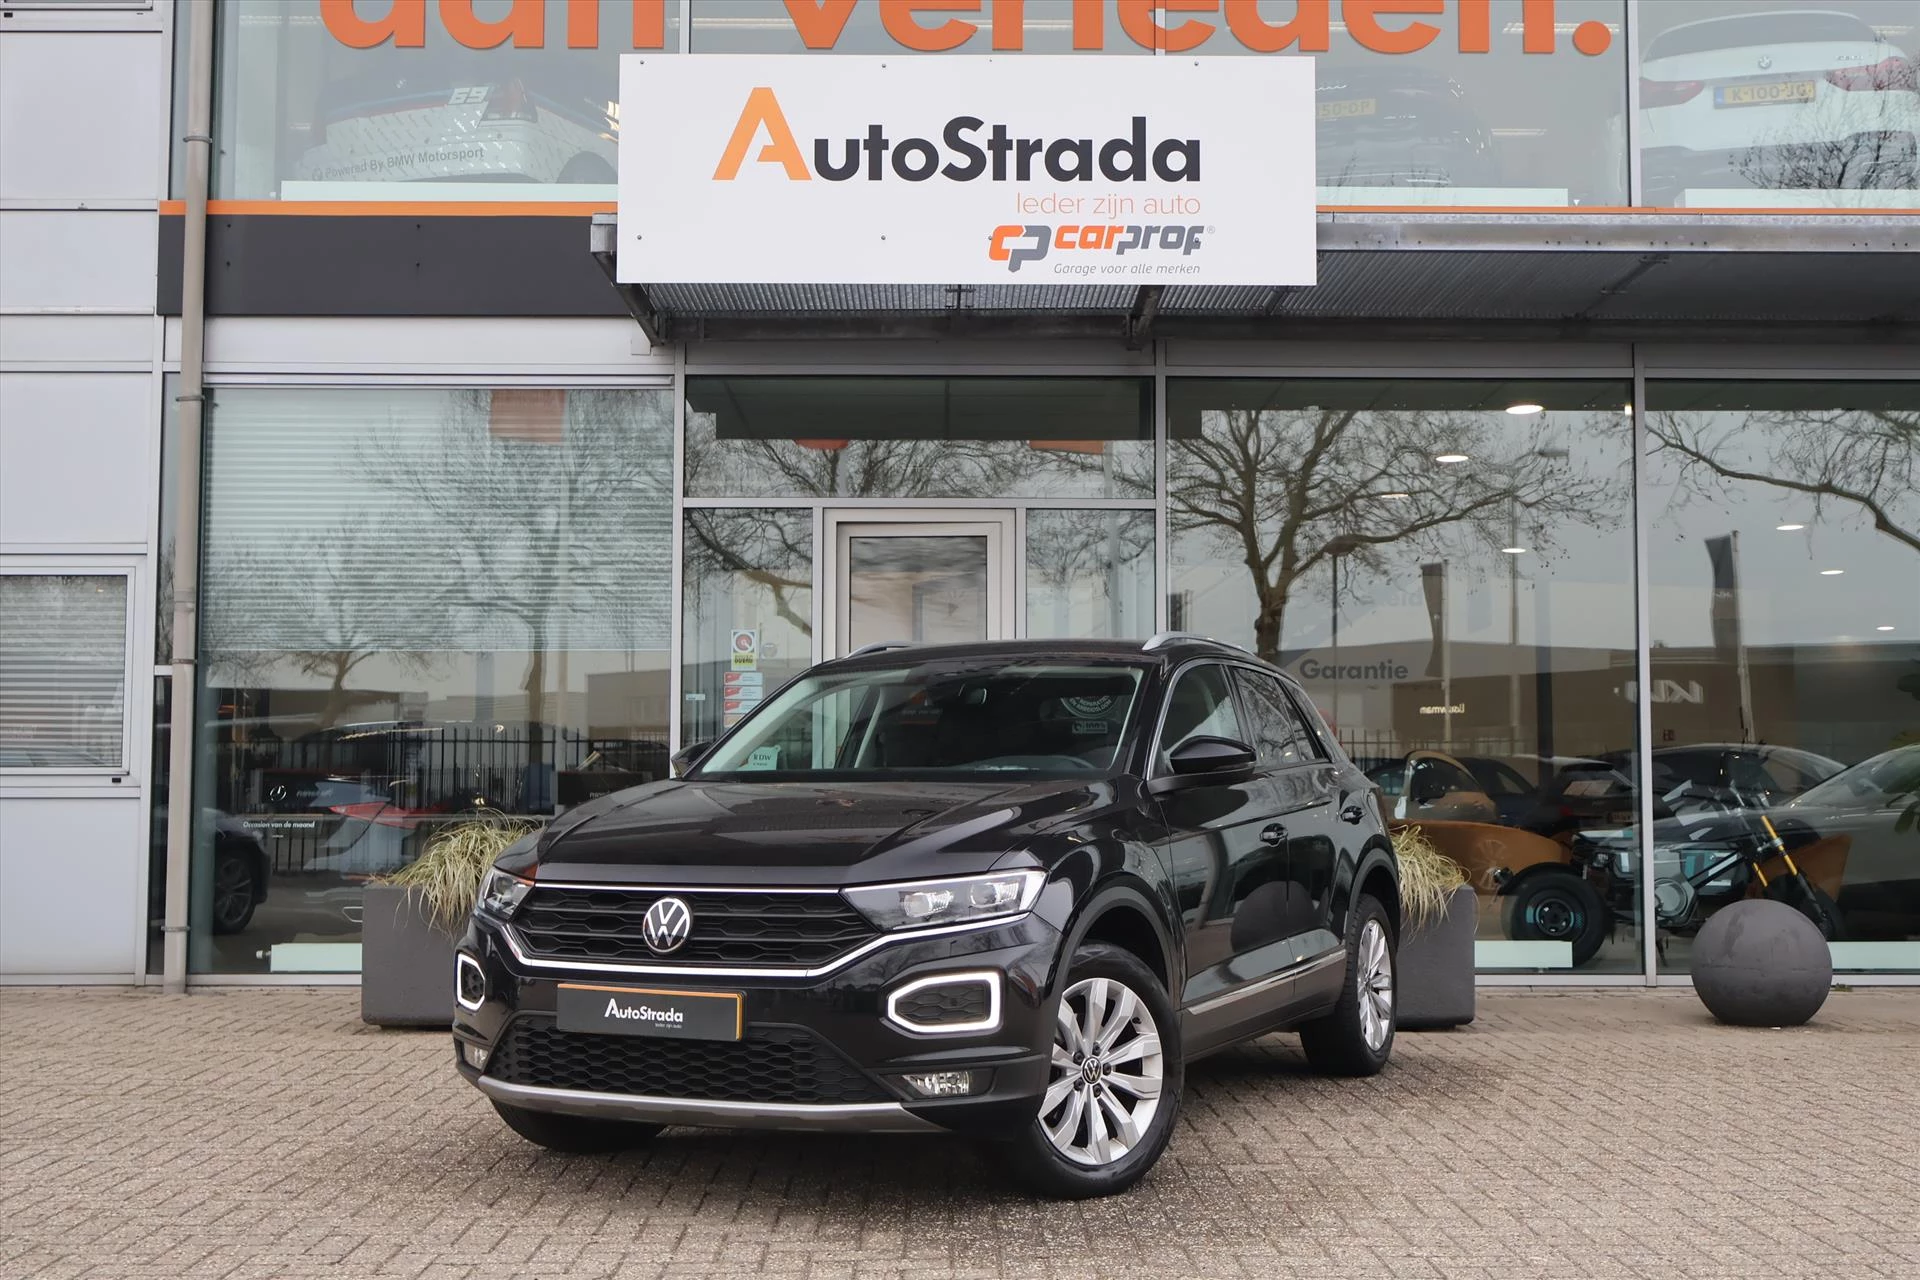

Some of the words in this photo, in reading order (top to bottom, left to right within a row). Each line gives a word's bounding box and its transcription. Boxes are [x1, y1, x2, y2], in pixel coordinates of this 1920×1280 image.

[451, 87, 488, 105] 69
[712, 87, 1201, 183] AutoStrada
[325, 159, 368, 178] Powered
[370, 158, 385, 172] By
[387, 153, 415, 169] BMW
[418, 147, 485, 163] Motorsport
[1016, 193, 1085, 214] Ieder
[1092, 193, 1135, 219] zijn
[1143, 194, 1201, 215] auto
[1053, 263, 1097, 277] Garage
[1100, 265, 1128, 275] voor
[1130, 263, 1153, 275] alle
[1156, 263, 1201, 275] merken
[1299, 658, 1409, 680] Garantie
[292, 820, 316, 829] maand
[604, 998, 683, 1022] AutoStrada
